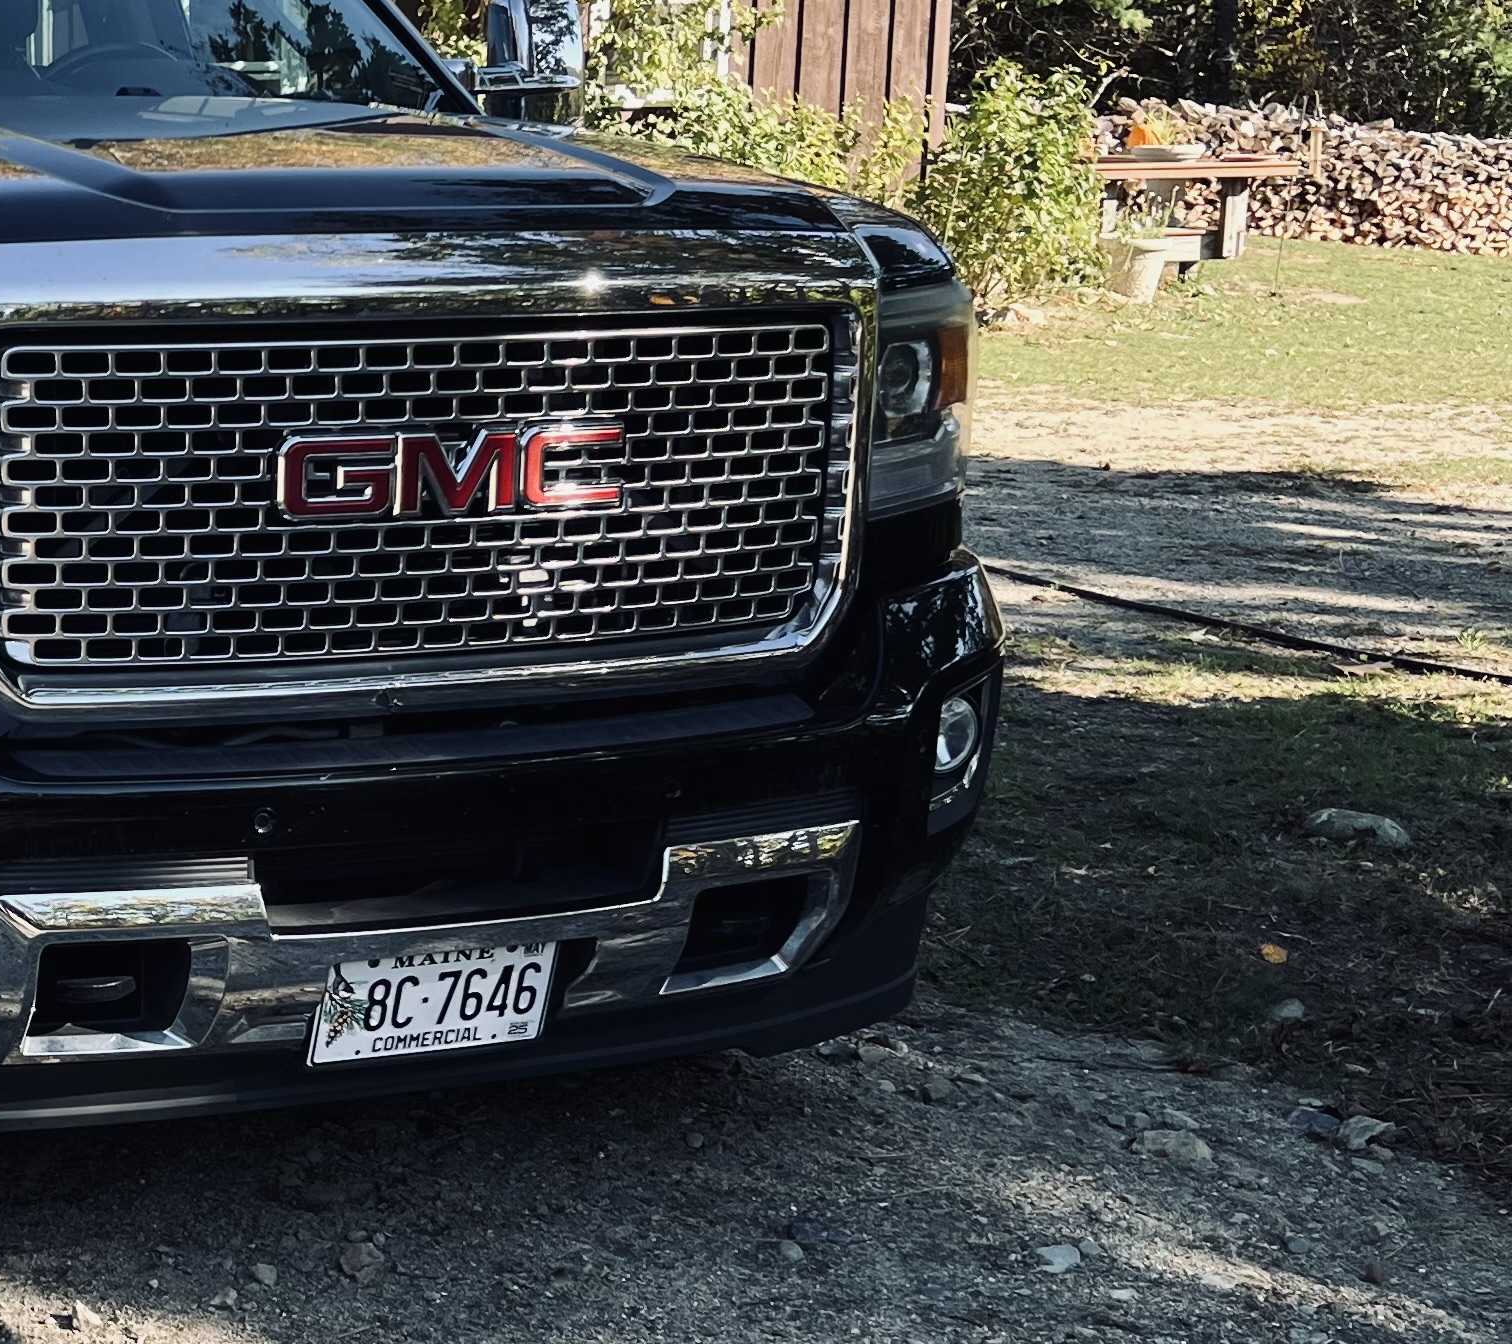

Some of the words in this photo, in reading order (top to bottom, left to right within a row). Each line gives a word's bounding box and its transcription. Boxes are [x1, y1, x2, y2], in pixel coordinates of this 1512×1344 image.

[276, 422, 625, 522] GMC
[391, 946, 495, 969] MAINE
[372, 1027, 481, 1052] COMMERCIAL
